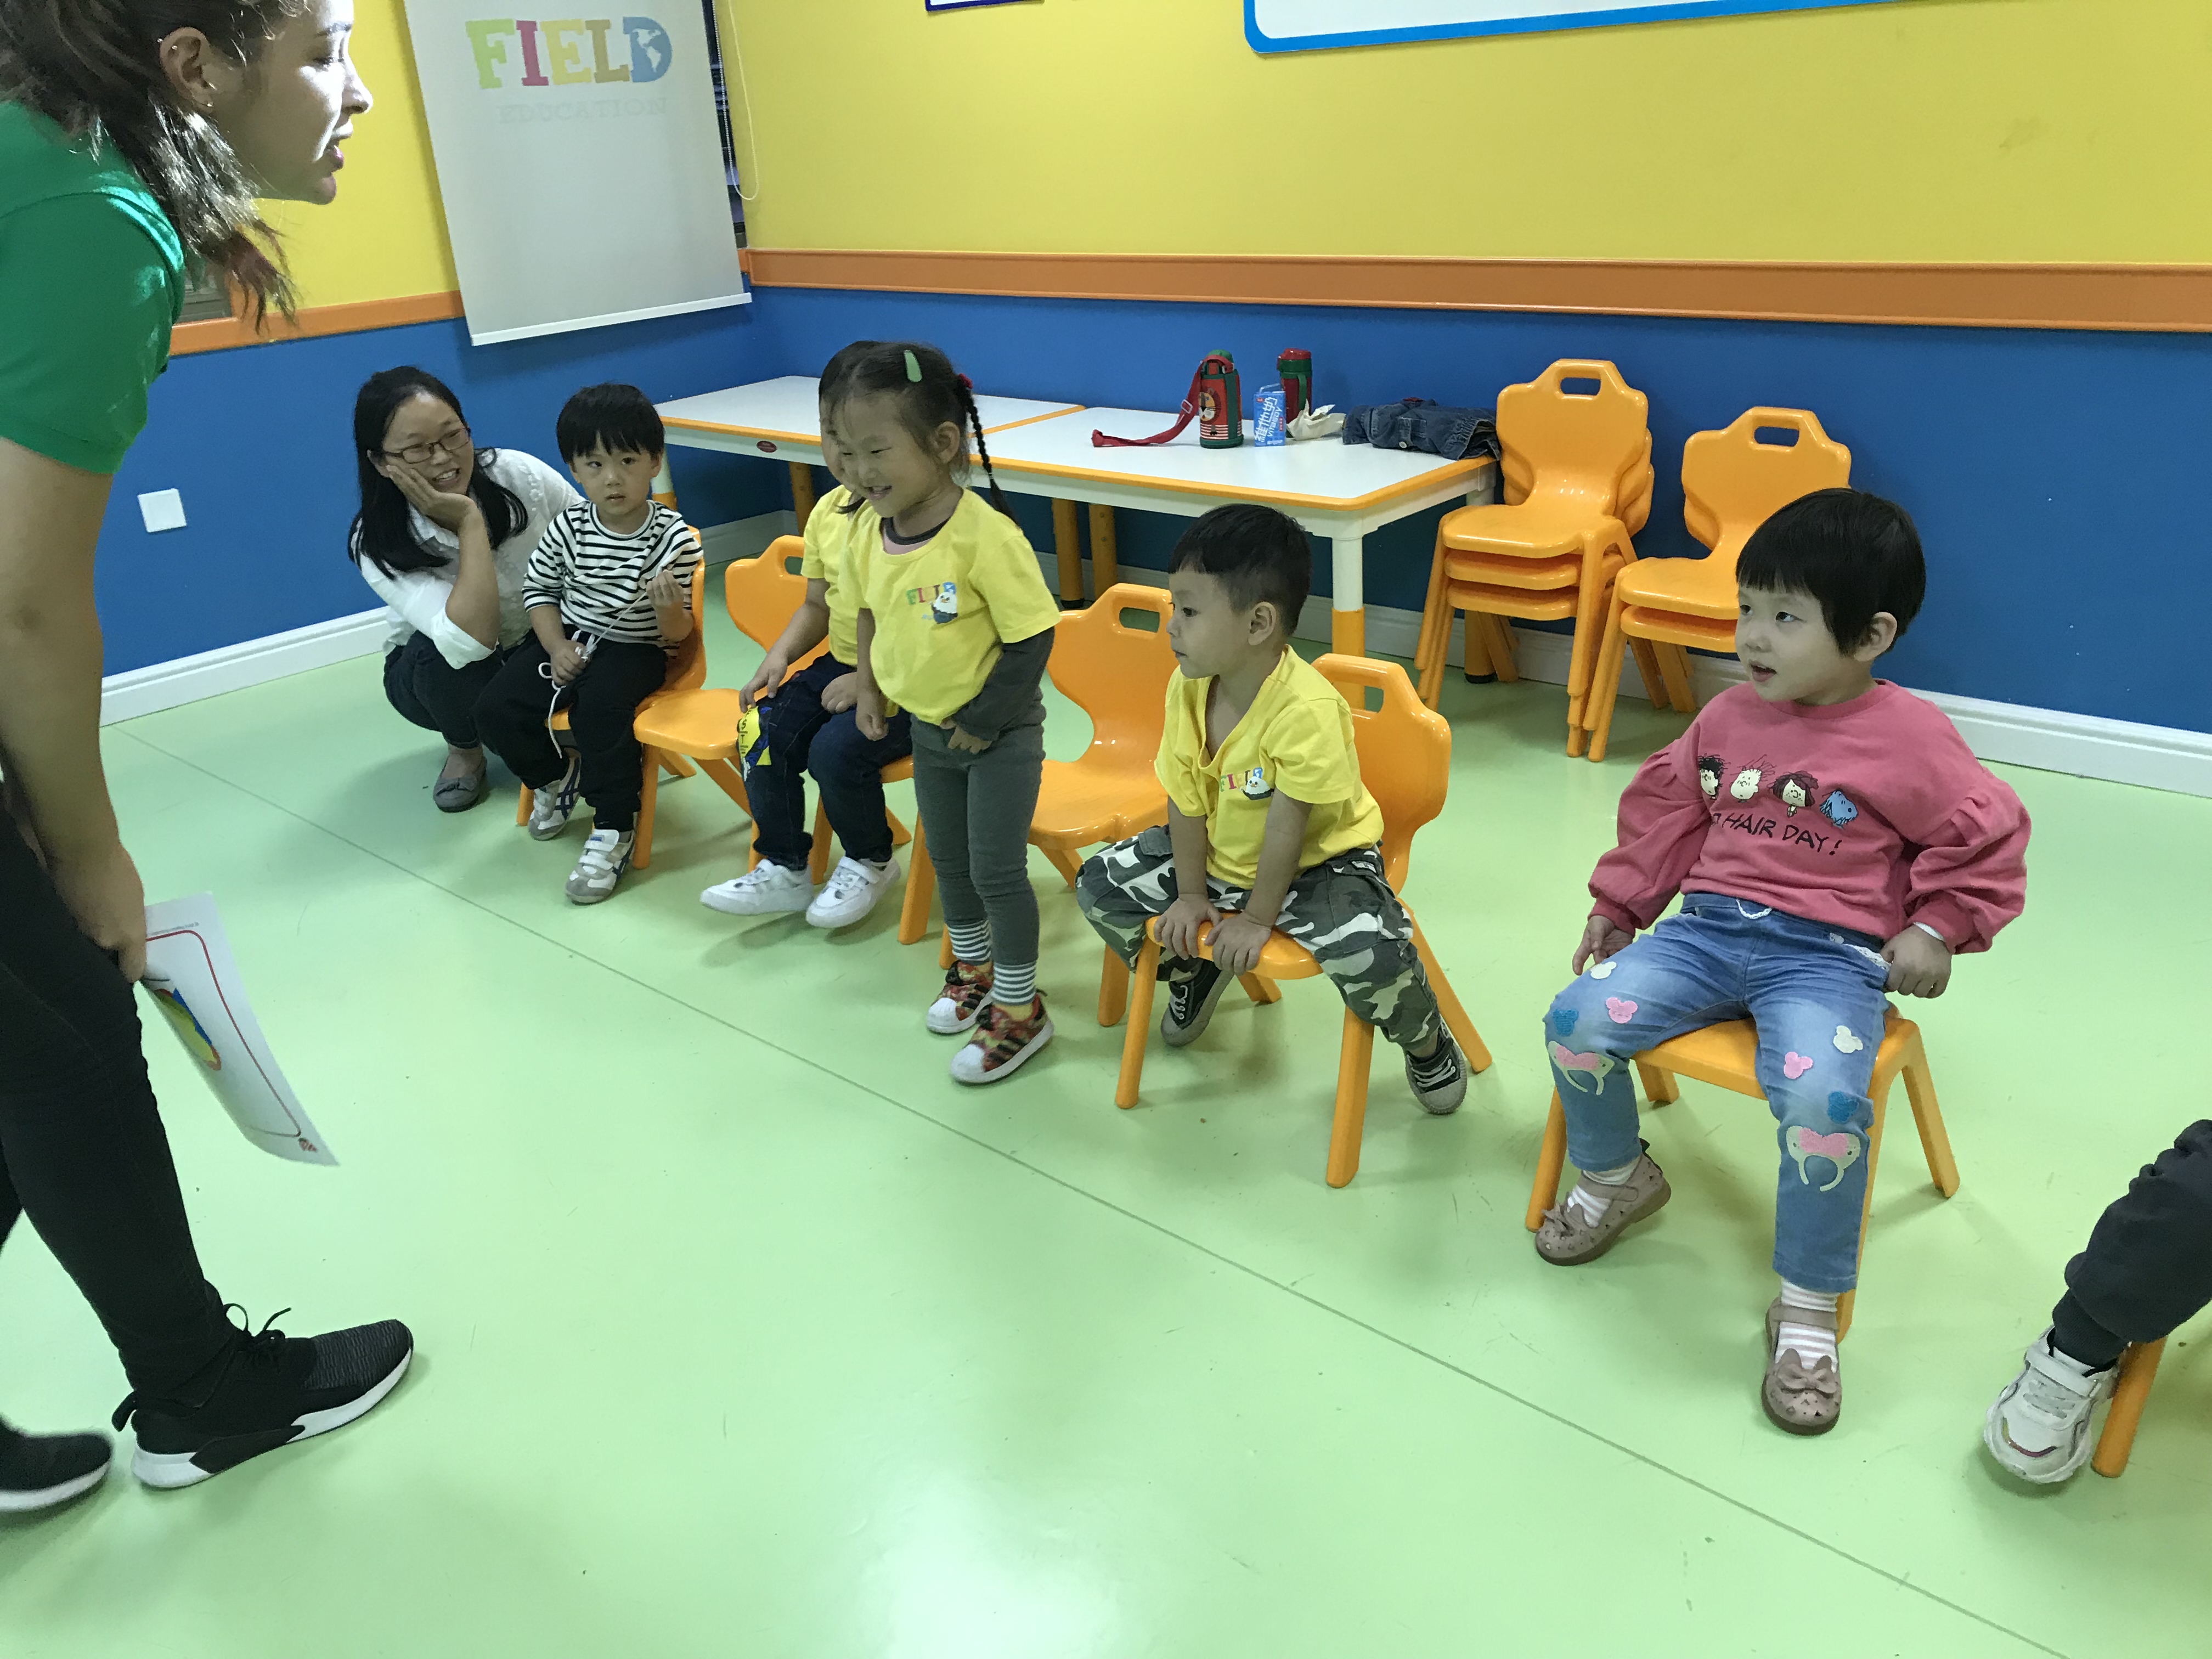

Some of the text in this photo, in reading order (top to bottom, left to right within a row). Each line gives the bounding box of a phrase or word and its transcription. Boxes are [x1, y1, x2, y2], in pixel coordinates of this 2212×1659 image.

[465, 16, 673, 89] FIELD
[496, 97, 668, 124] EDUCATION
[1722, 812, 1777, 838] HAIR
[1782, 824, 1843, 856] DAY!
